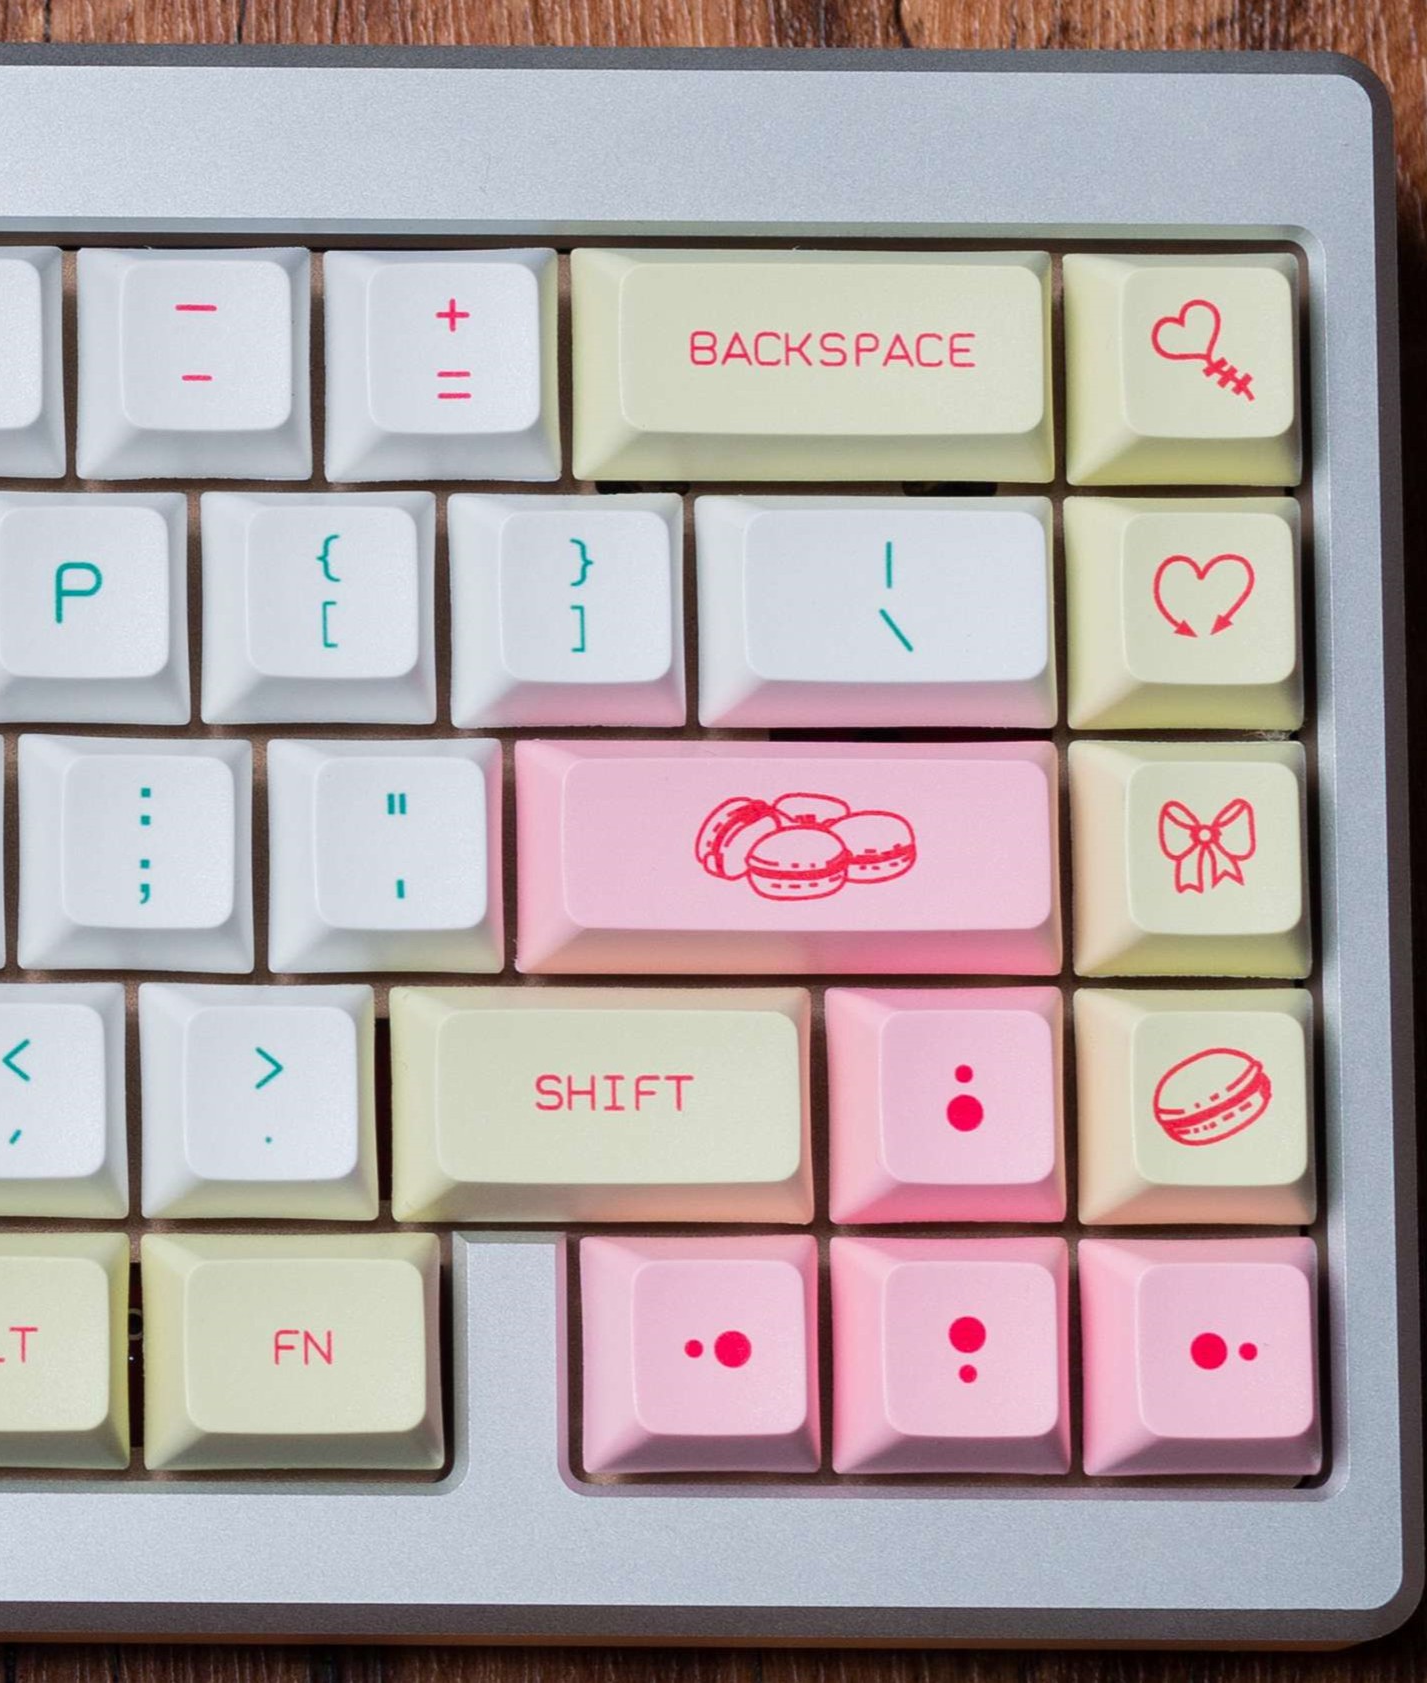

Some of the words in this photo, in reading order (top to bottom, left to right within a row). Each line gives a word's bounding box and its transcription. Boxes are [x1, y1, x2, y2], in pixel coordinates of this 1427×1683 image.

[435, 298, 470, 333] +
[689, 330, 976, 368] BACKSPACE
[436, 370, 472, 400] =
[316, 533, 341, 583] {
[569, 538, 594, 588] }
[54, 561, 104, 625] P
[321, 599, 339, 649] [
[570, 604, 587, 654] ]
[878, 608, 914, 653] \
[386, 792, 408, 816] "
[1, 1038, 31, 1082] <
[255, 1047, 284, 1090] >
[534, 1074, 694, 1112] SHIFT
[273, 1329, 333, 1366] FN
